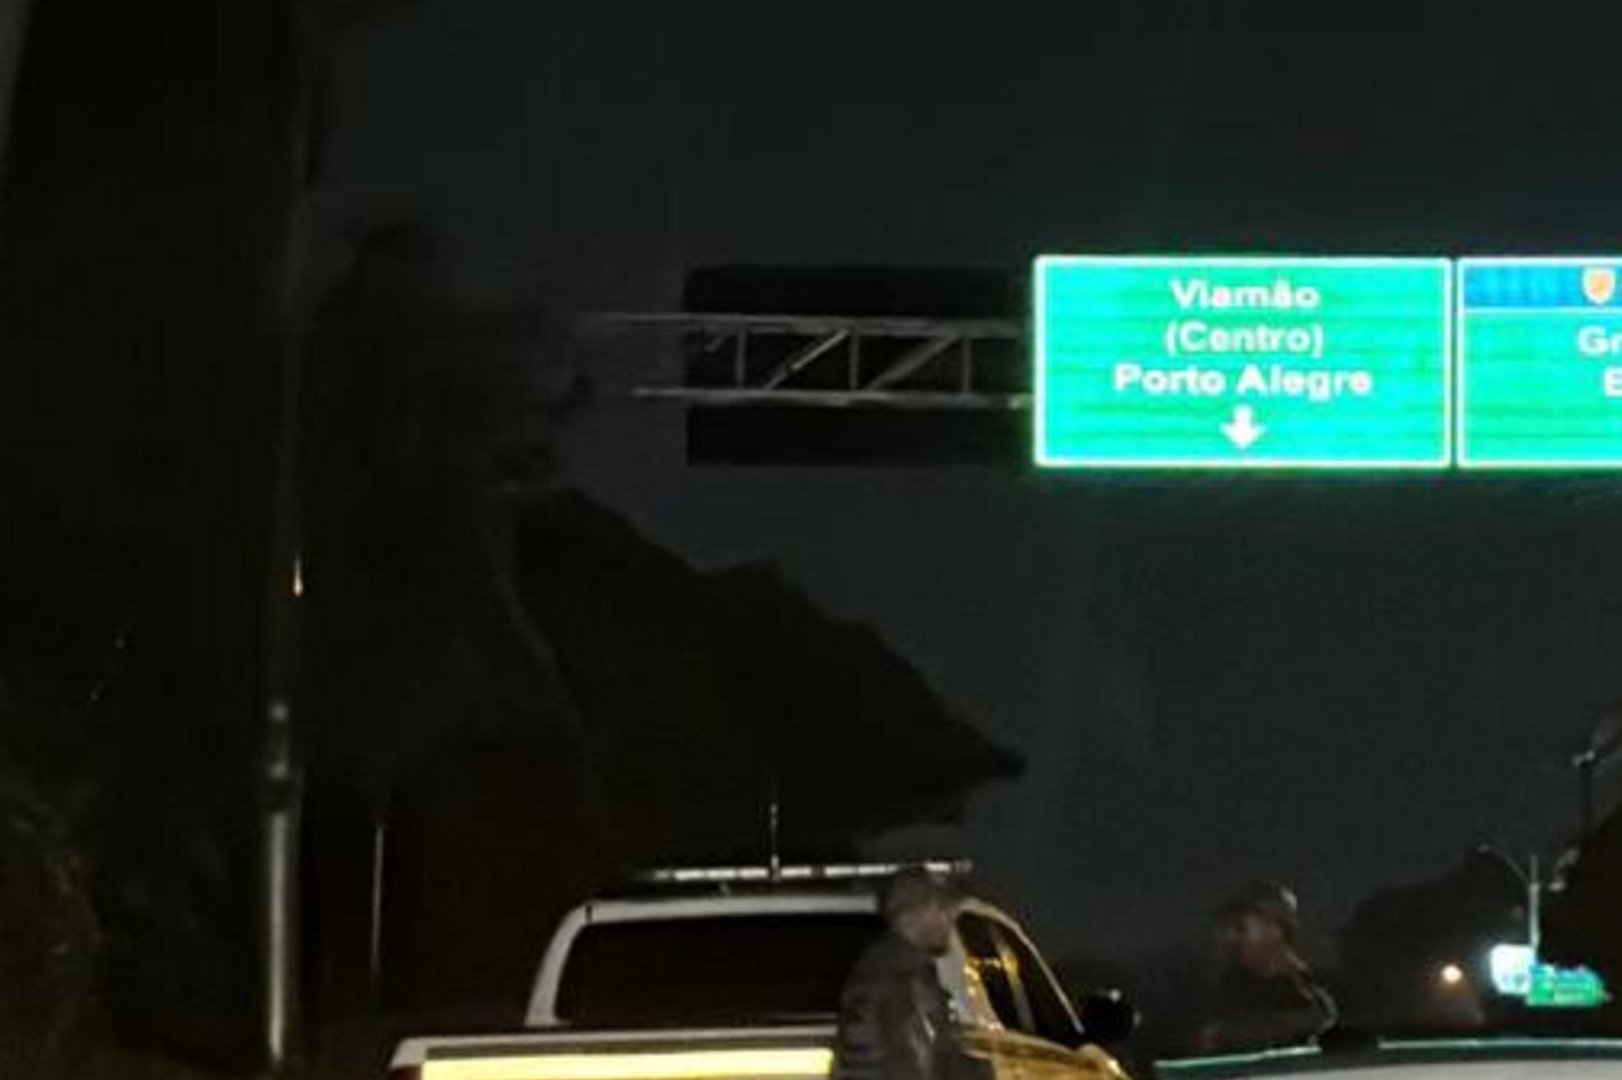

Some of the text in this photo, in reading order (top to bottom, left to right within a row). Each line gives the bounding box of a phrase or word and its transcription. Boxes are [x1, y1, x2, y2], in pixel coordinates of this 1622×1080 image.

[1169, 277, 1321, 309] Viamão
[1165, 319, 1324, 359] (Centro)
[1114, 362, 1373, 402] Porto Alegre
